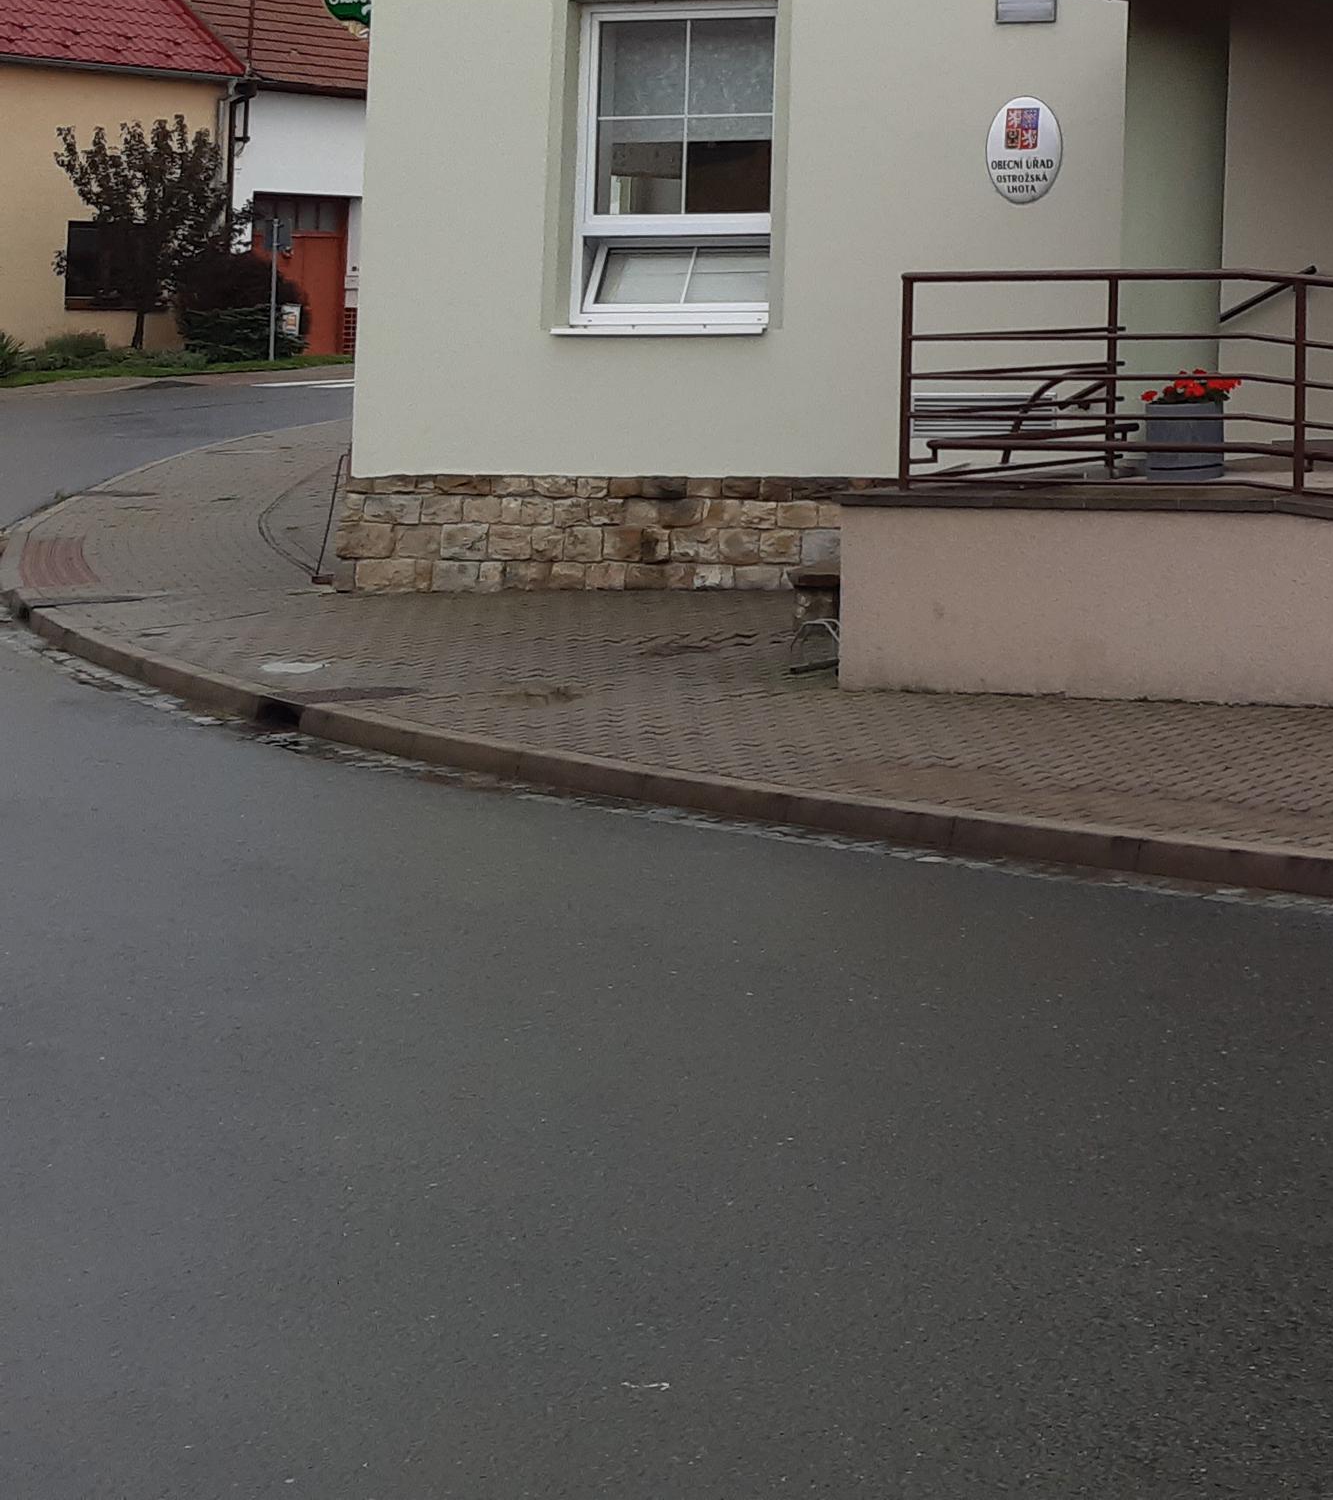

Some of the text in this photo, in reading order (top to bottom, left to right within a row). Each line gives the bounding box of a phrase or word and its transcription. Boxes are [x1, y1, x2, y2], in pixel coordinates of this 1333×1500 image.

[991, 157, 1023, 170] OBECNÍ
[996, 172, 1048, 183] OSTROŽSKÁ
[1007, 184, 1037, 194] LHOTA
